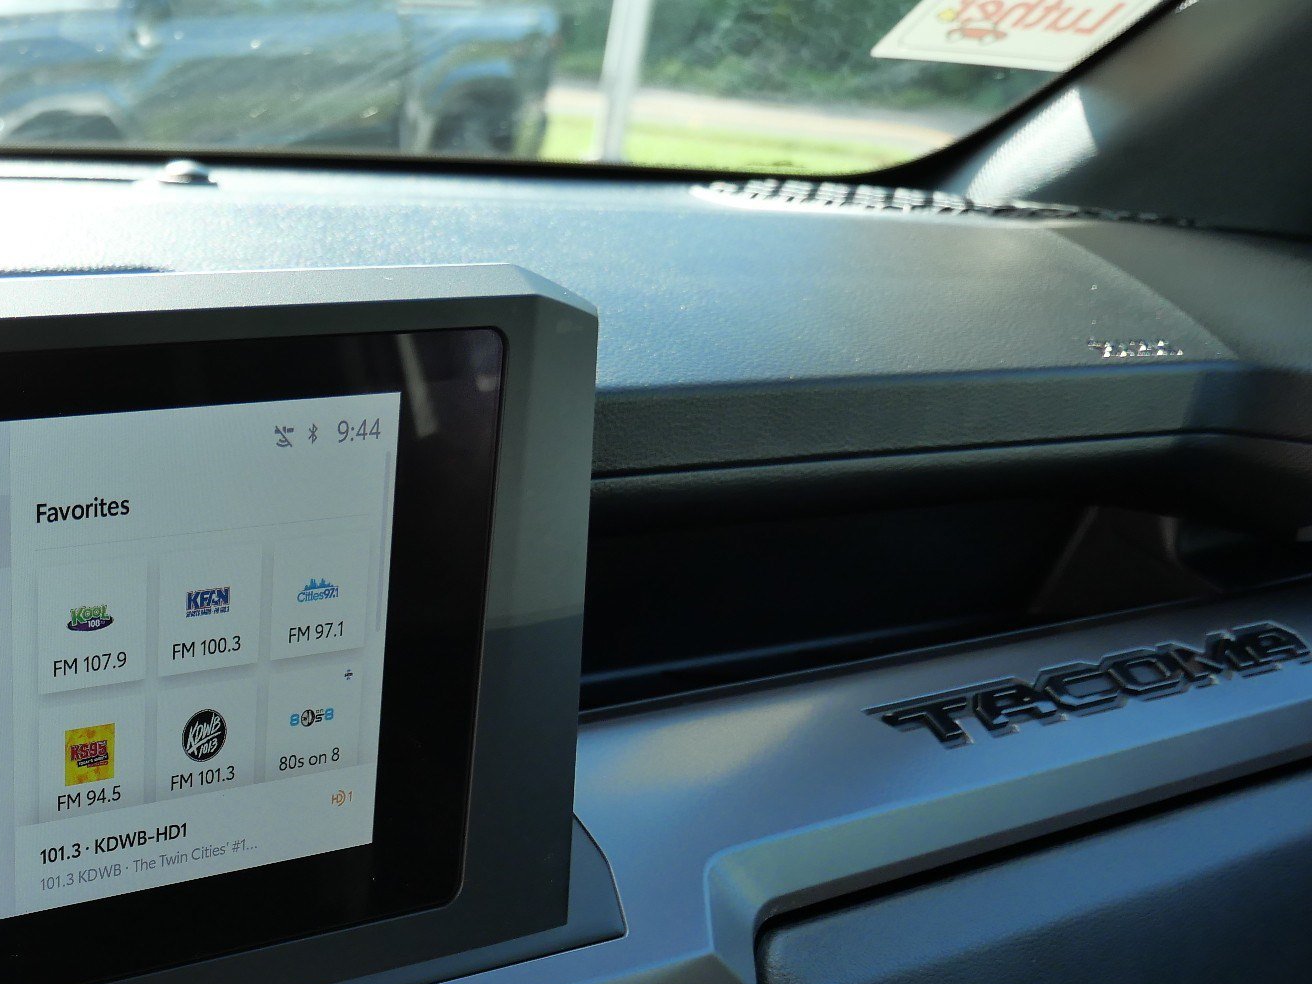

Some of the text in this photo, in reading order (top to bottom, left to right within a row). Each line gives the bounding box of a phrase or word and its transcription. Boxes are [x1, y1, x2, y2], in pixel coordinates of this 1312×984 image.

[337, 418, 381, 443] 9:44
[36, 497, 130, 523] Favorites
[288, 621, 344, 643] FM 97.1
[172, 636, 241, 660] FM 100.3
[53, 651, 127, 677] FM 107.9
[864, 620, 1311, 747] TACOMA
[279, 747, 340, 771] 80s on 8
[170, 766, 235, 791] FM 101.3
[57, 785, 121, 811] FM 94.5
[40, 823, 188, 864] 101.3 KDWB-HD1
[40, 873, 74, 891] 101.3
[78, 863, 122, 885] KDWB
[133, 857, 157, 873] The
[159, 851, 188, 869] Twin
[191, 841, 230, 861] Cities'
